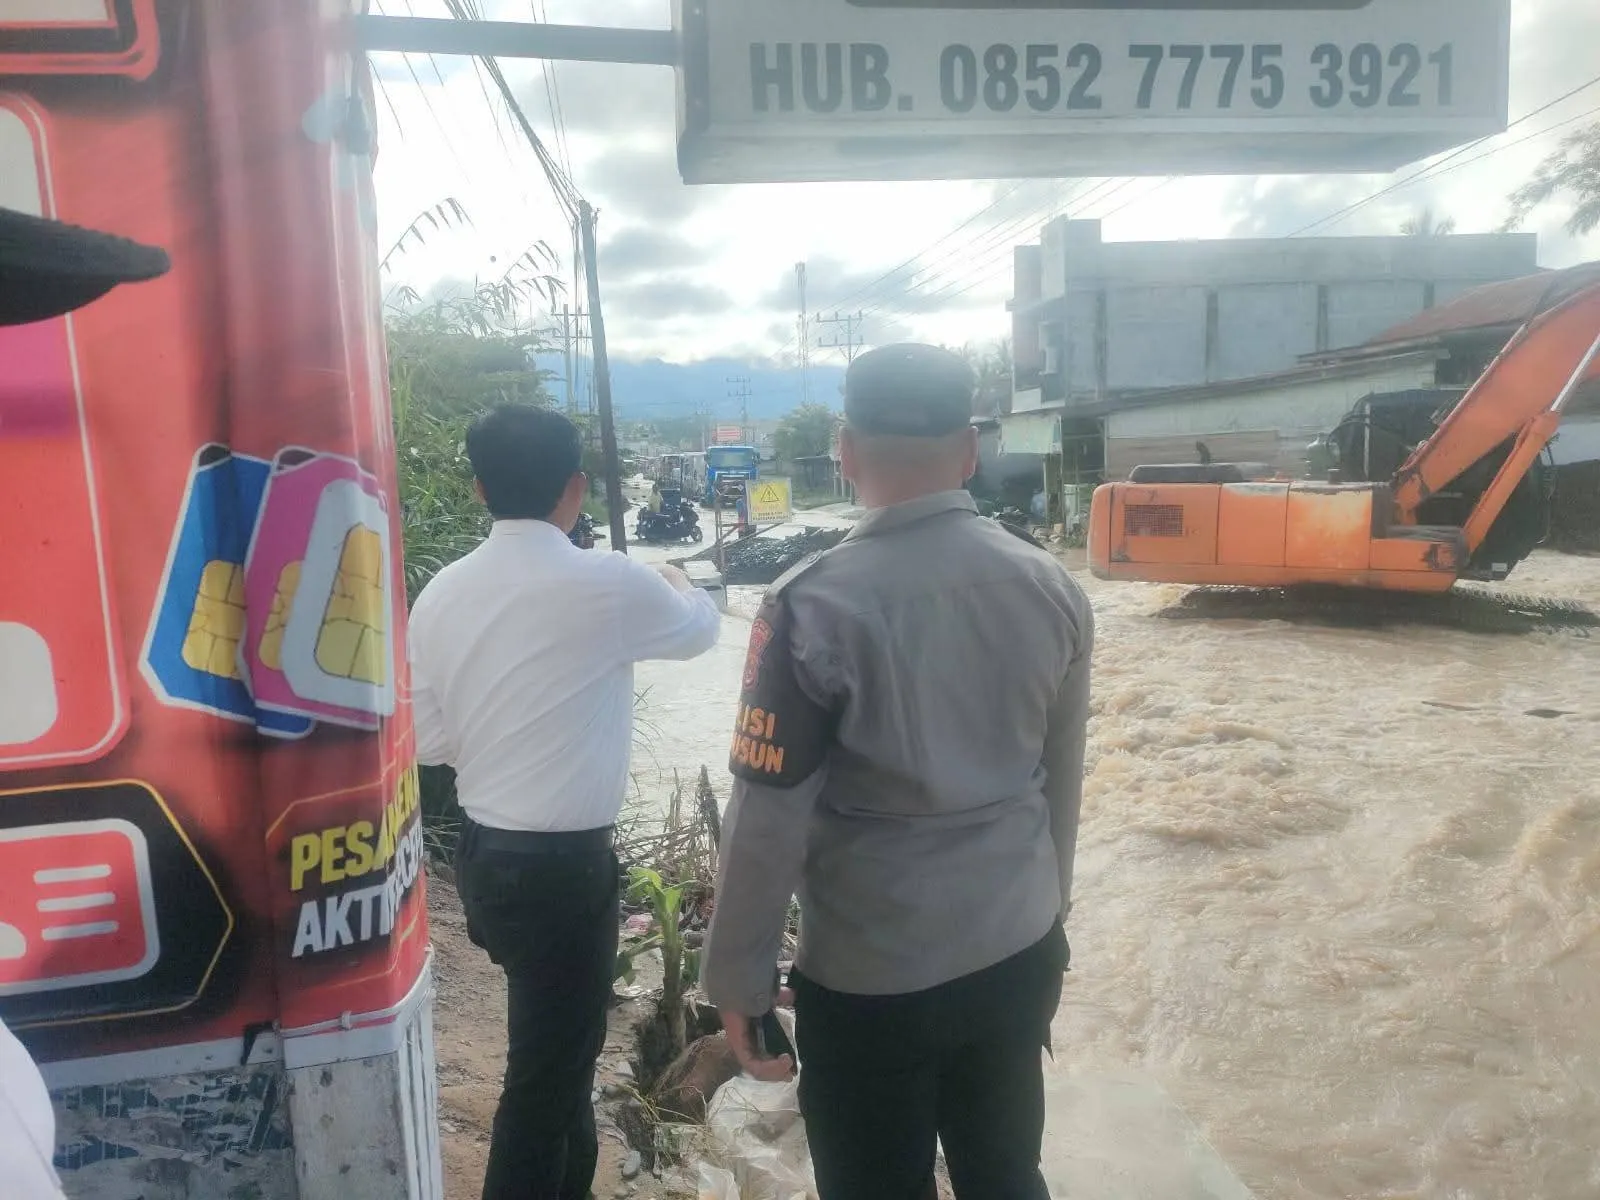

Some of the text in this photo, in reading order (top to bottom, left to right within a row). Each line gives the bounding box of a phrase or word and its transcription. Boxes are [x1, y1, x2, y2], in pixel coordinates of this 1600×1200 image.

[750, 42, 1453, 113] HUB. 0852 7775 3921
